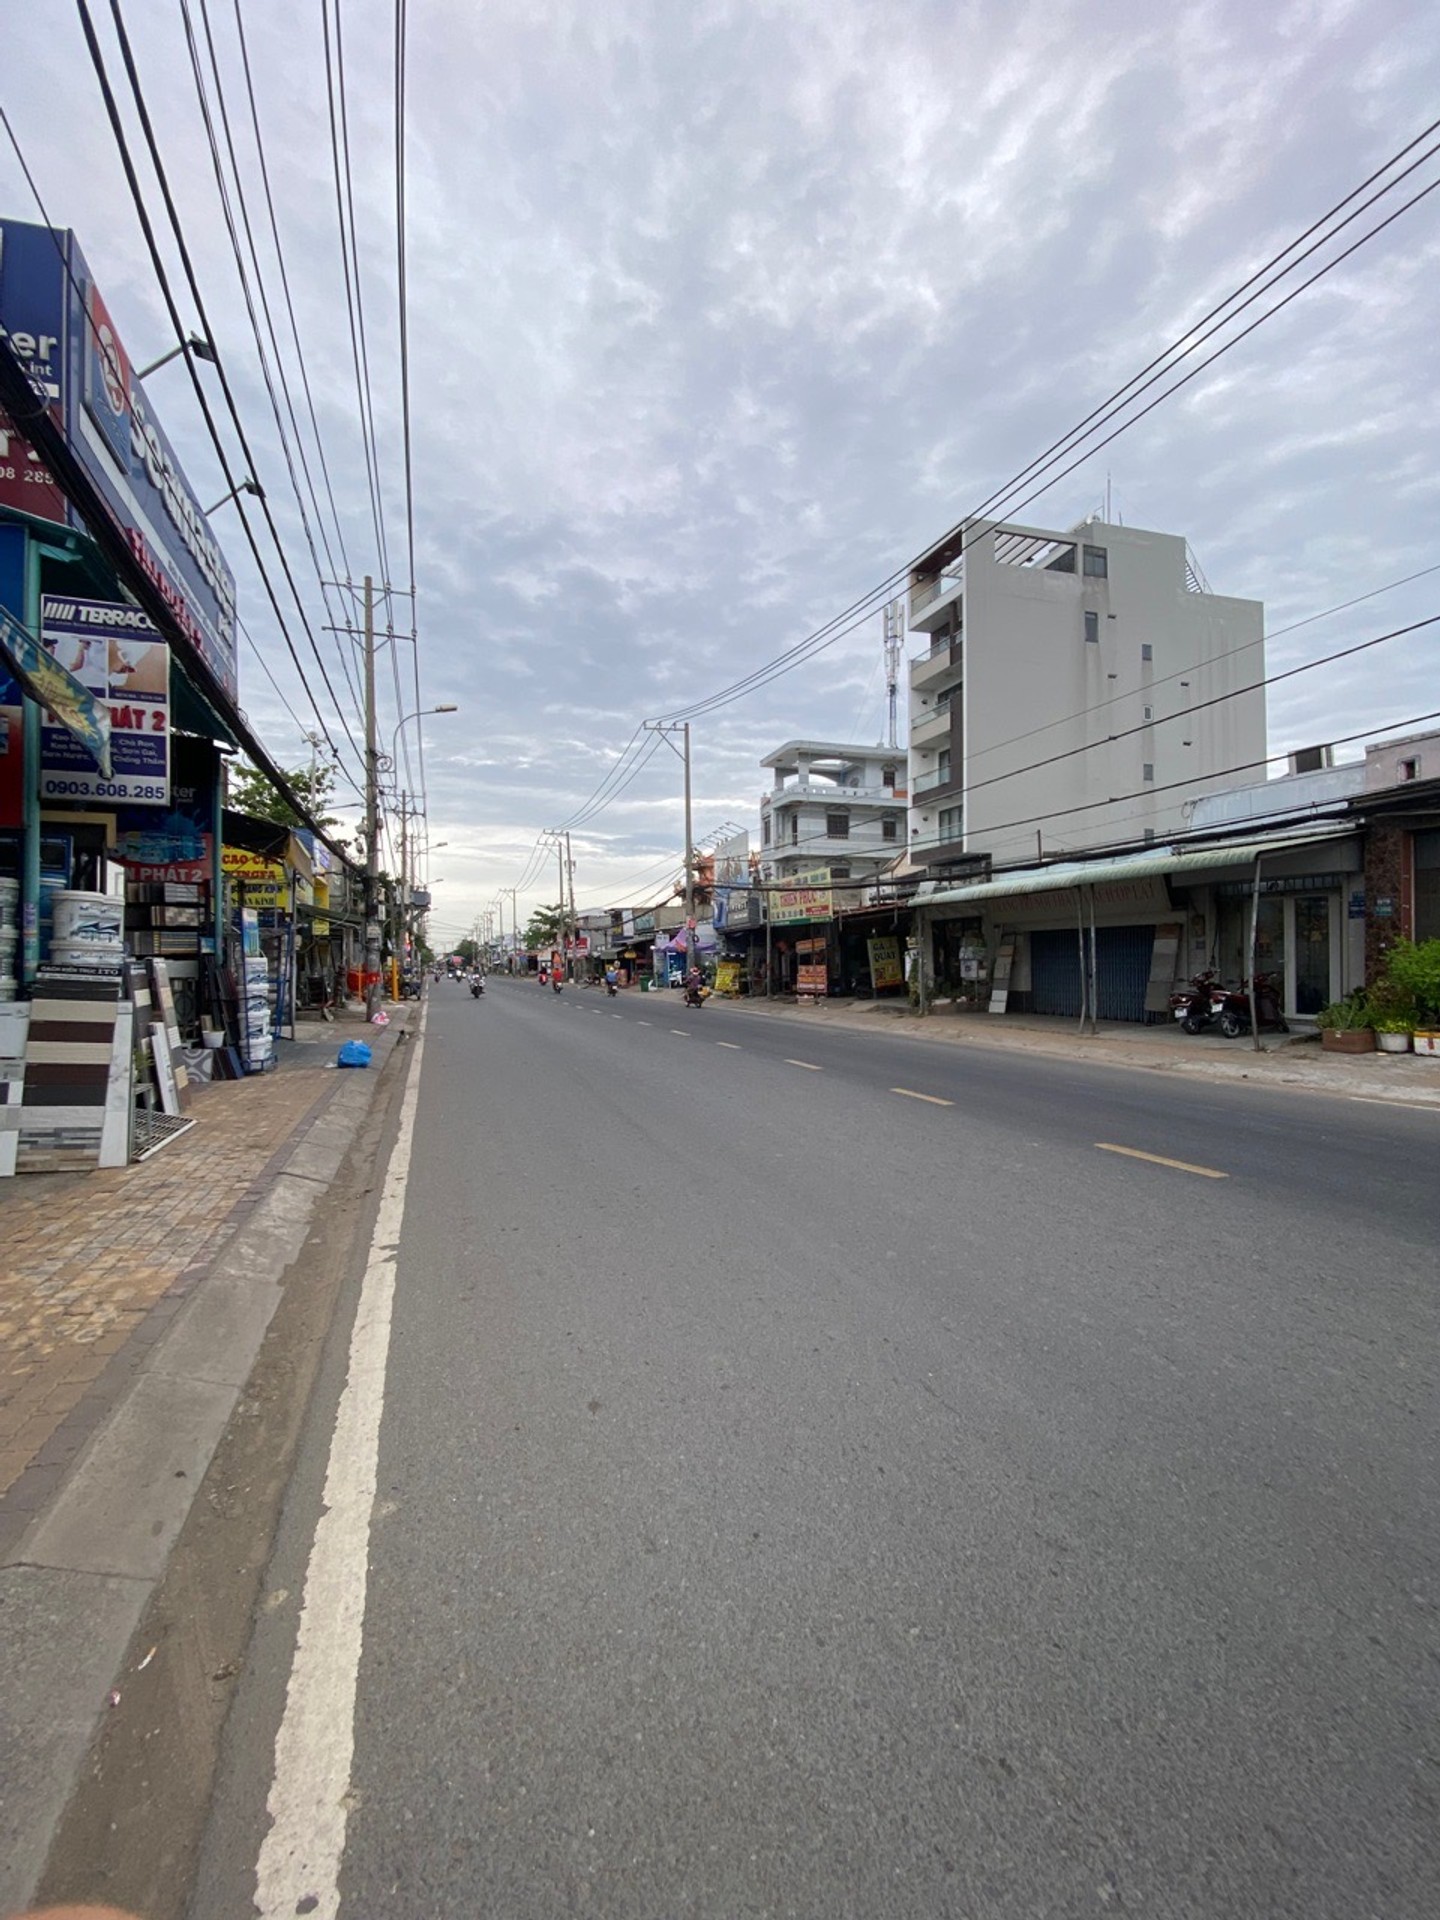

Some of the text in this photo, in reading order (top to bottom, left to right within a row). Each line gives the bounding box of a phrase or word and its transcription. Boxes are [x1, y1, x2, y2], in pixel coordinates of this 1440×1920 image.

[0, 325, 58, 360] er
[152, 711, 166, 732] 2
[46, 779, 165, 800] 0903.608.285
[140, 865, 189, 882] PHÁT
[191, 869, 204, 883] 2
